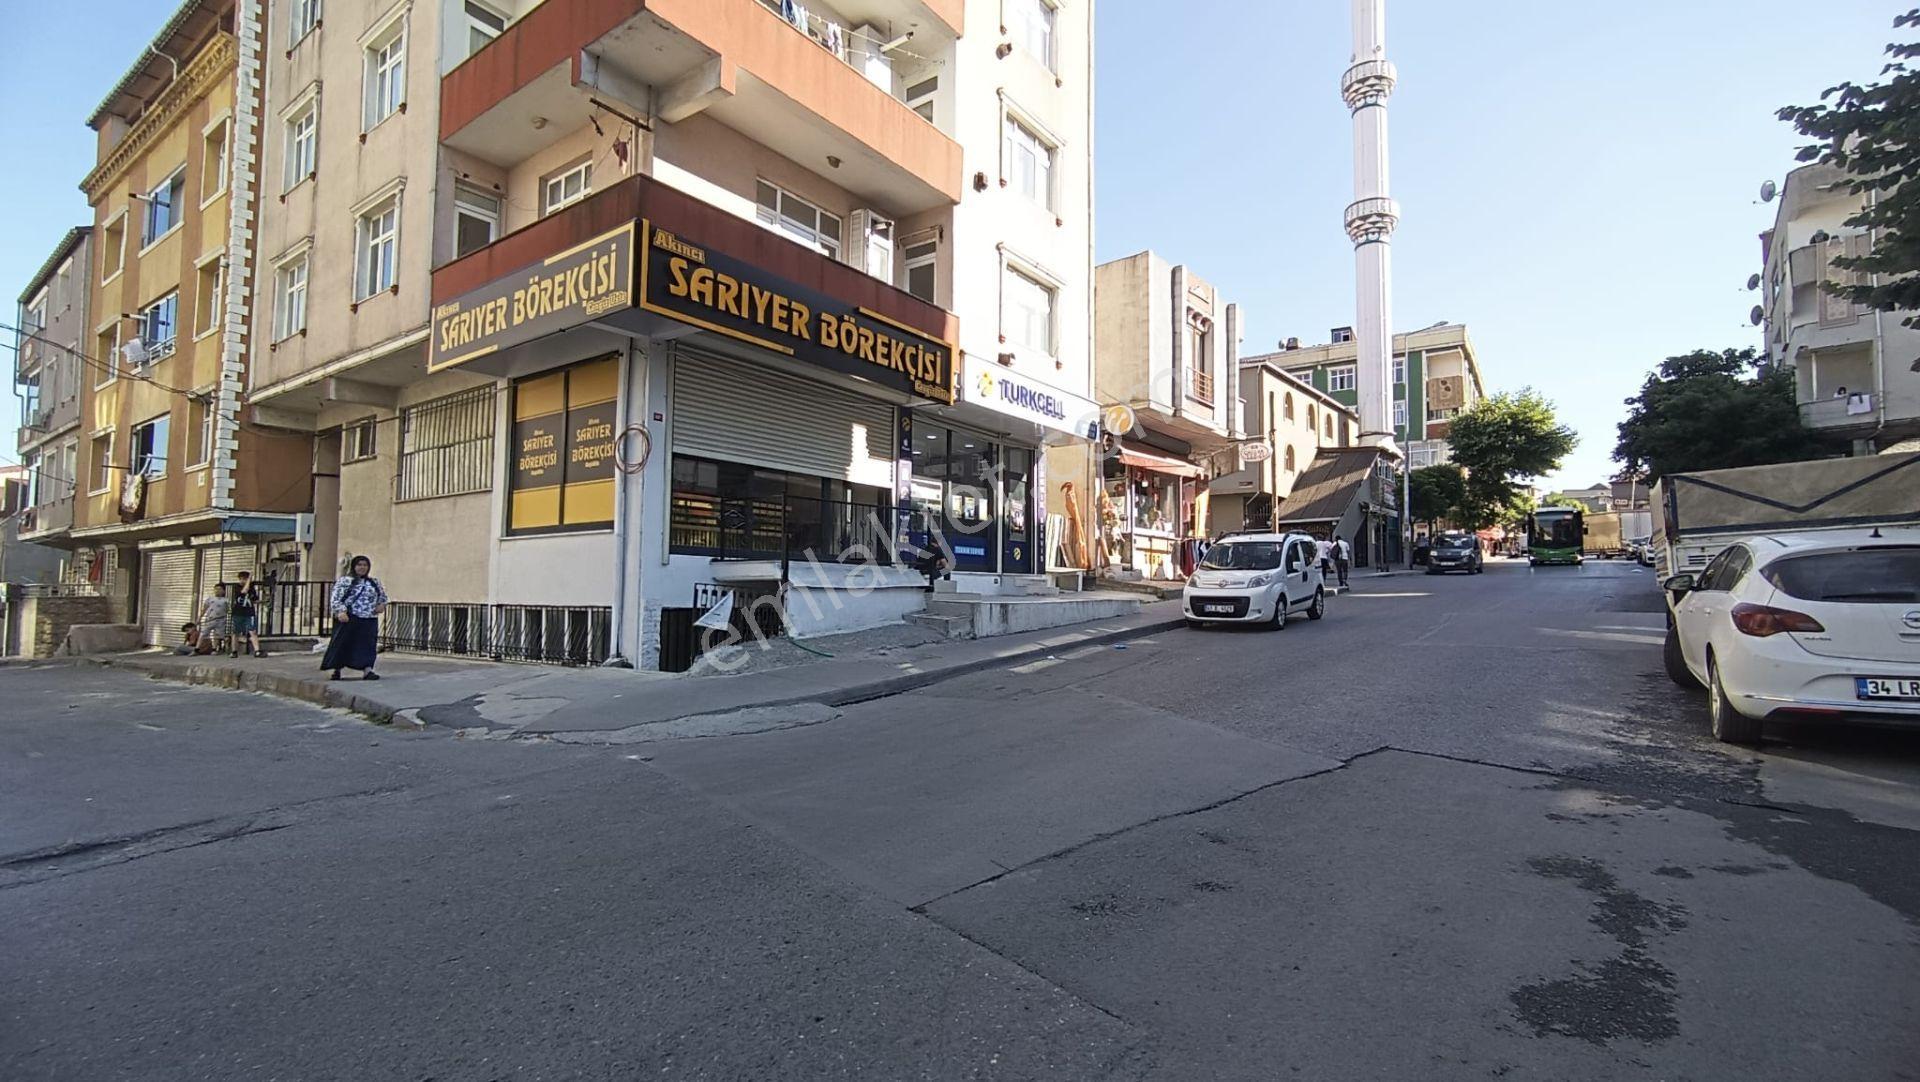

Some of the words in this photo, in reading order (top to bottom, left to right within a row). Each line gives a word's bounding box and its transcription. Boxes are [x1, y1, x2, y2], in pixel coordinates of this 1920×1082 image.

[440, 296, 508, 352] SARIYER
[513, 243, 617, 326] BÖREKÇİSİ
[669, 257, 810, 340] SARIYER
[820, 313, 942, 384] BÖREKÇİSİ
[1000, 379, 1065, 419] TURKCELL
[575, 424, 611, 442] SARIYER
[523, 435, 554, 452] SARIYER
[572, 441, 615, 462] BÖREKÇİSİ
[520, 450, 557, 470] BÖREKÇİSİ
[1868, 680, 1891, 695] 34
[1898, 681, 1920, 695] LR
